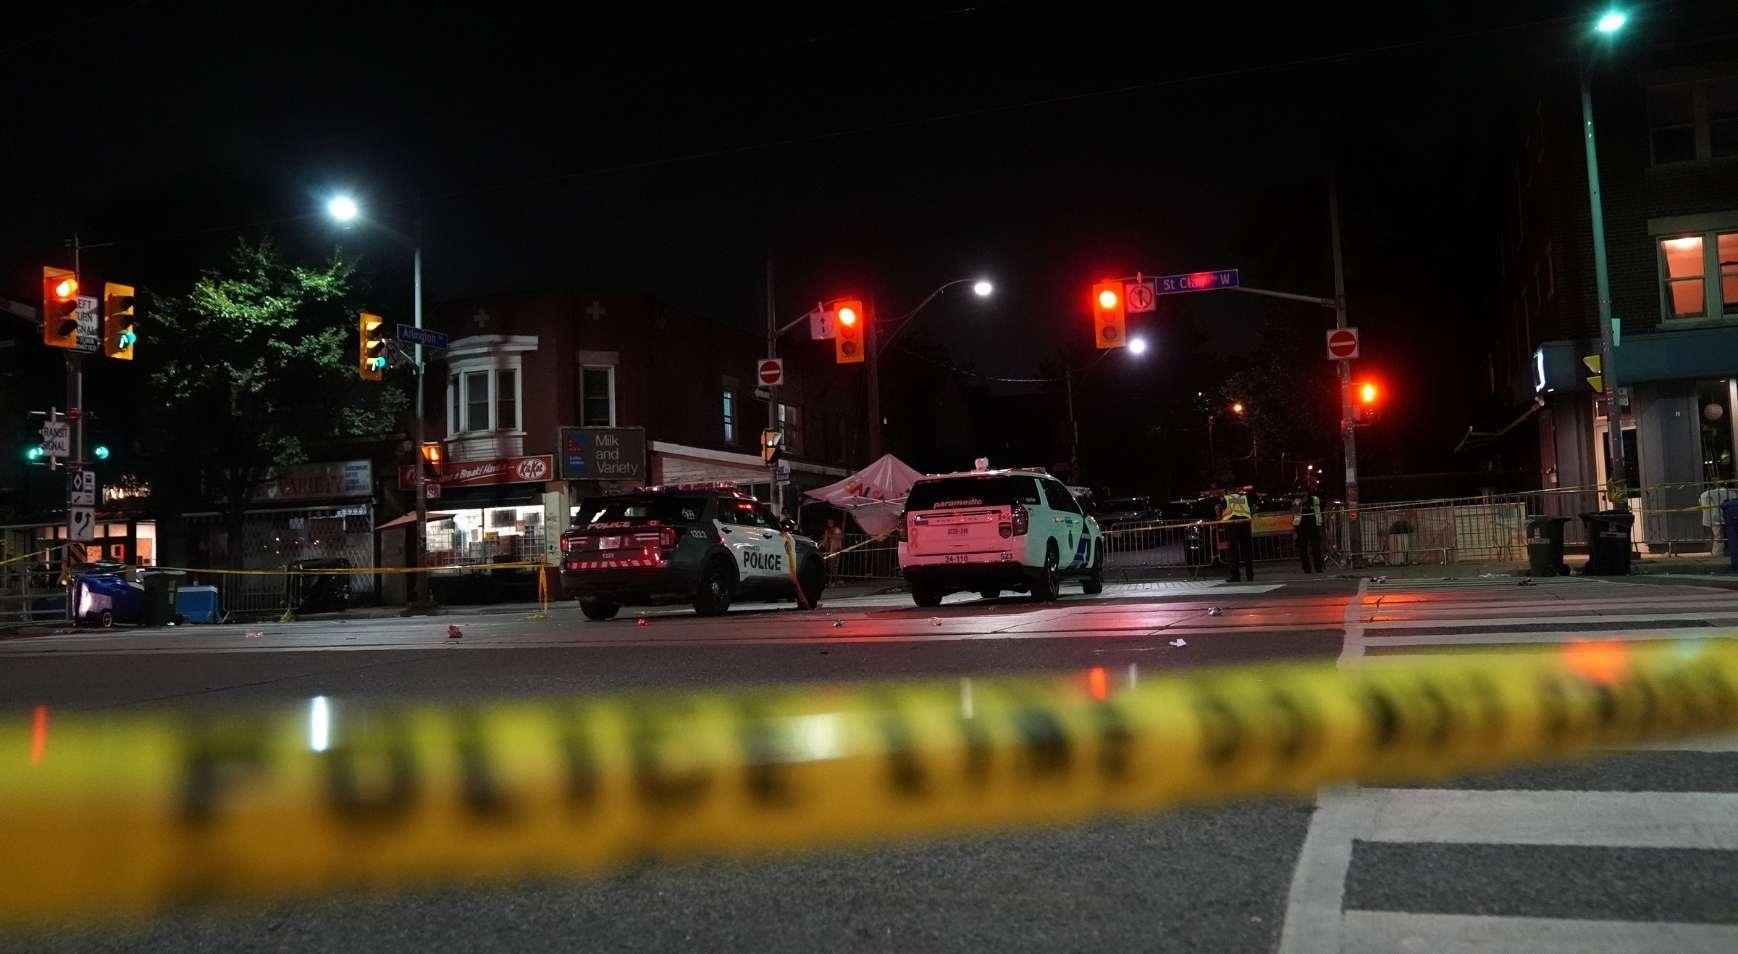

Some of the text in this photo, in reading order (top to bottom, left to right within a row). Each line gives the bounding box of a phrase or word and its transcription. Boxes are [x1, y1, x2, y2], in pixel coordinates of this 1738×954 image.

[1163, 279, 1176, 291] St
[1220, 272, 1230, 285] W
[595, 434, 620, 447] Milk
[595, 448, 619, 460] and
[596, 461, 638, 475] Variety
[933, 499, 983, 510] paramedic
[743, 551, 781, 571] POLICE
